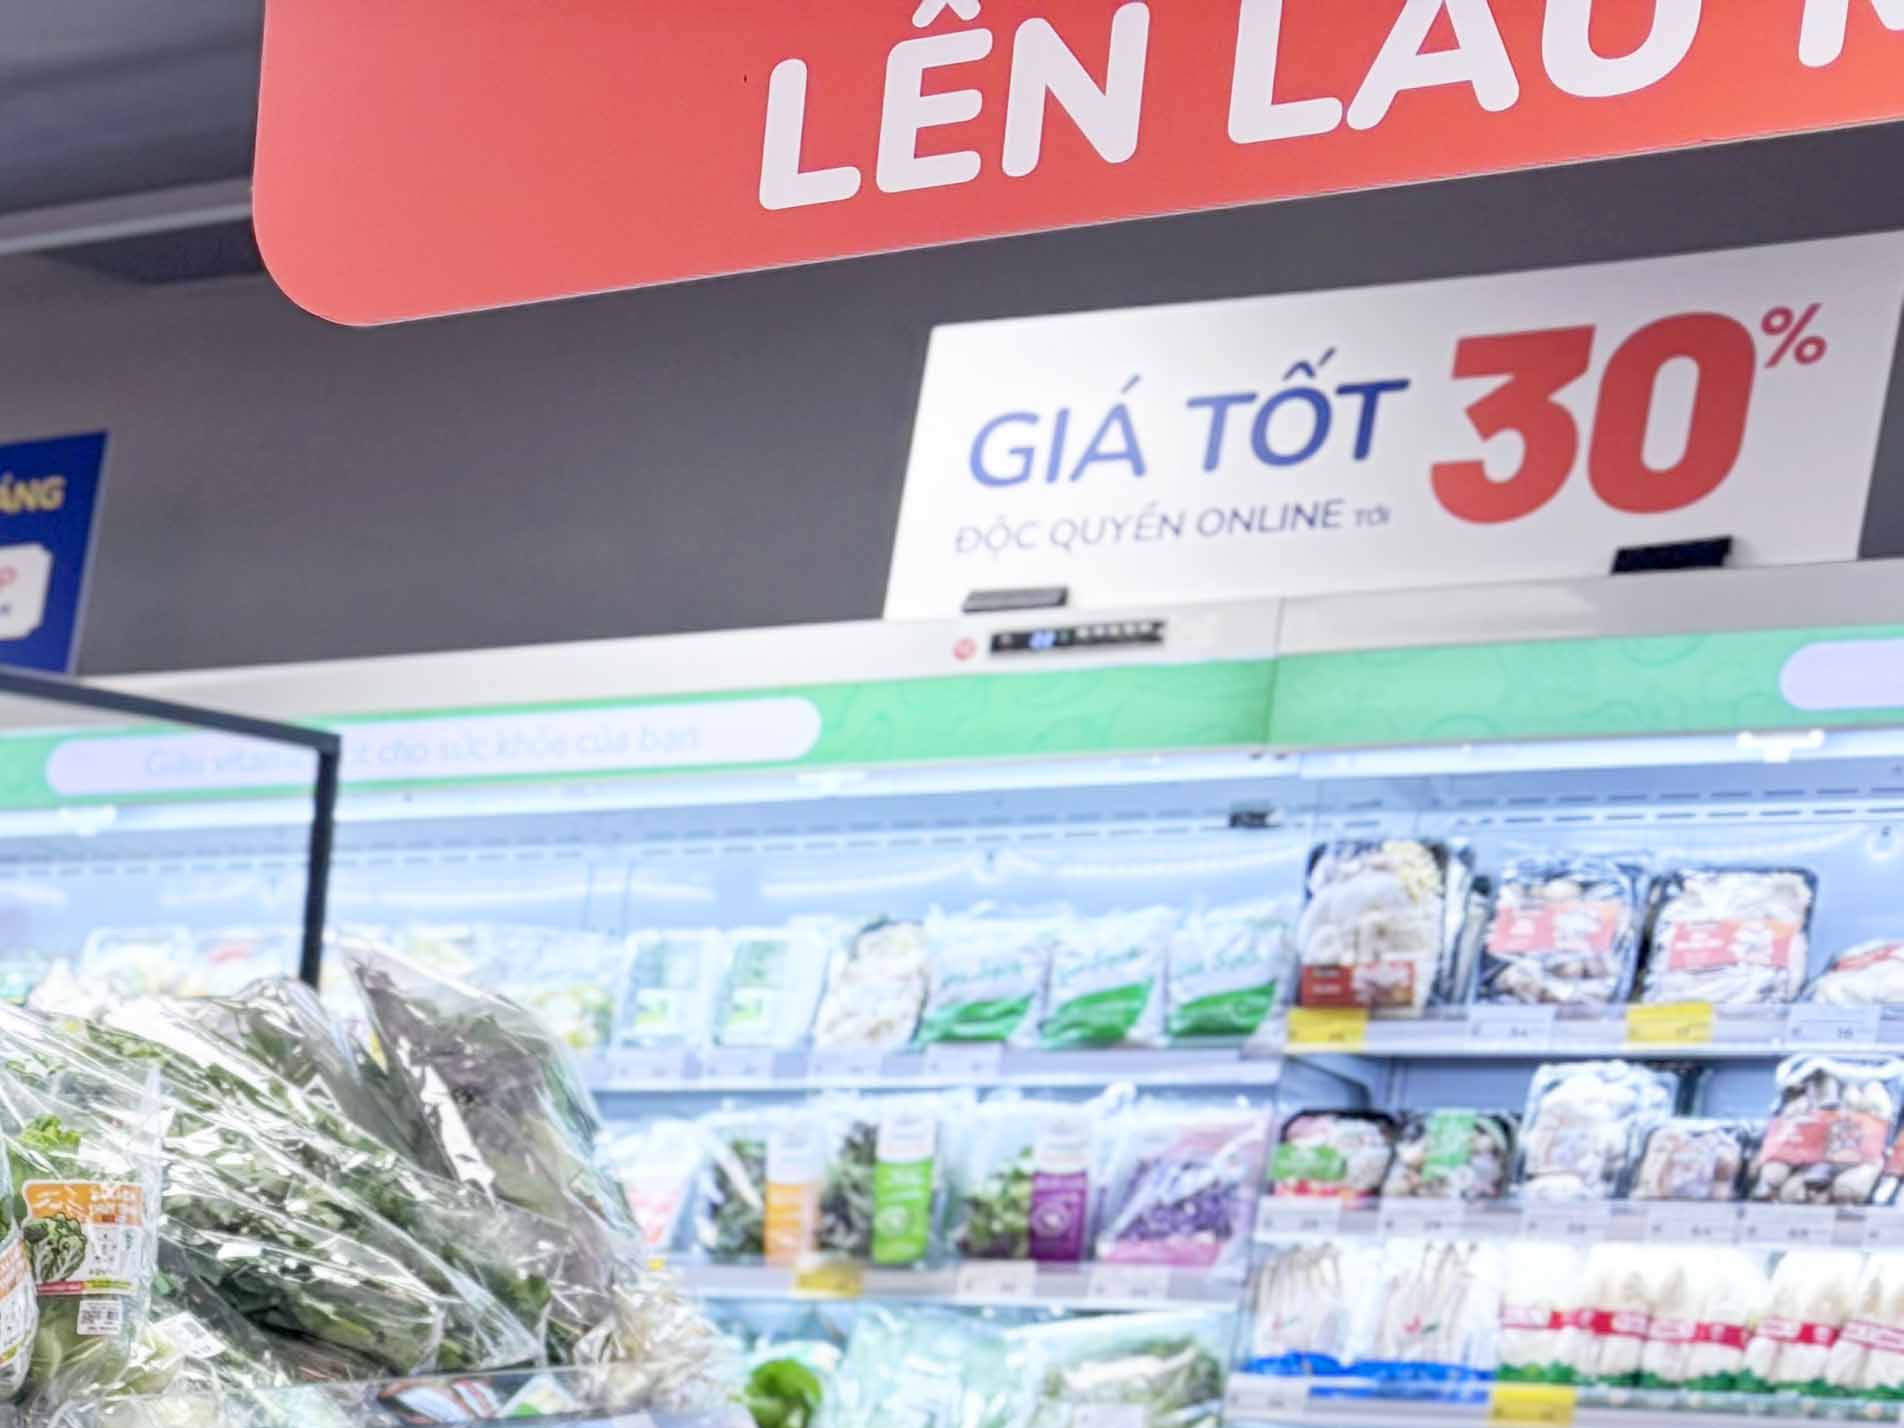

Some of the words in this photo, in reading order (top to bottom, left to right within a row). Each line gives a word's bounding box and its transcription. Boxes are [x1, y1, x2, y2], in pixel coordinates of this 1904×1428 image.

[759, 0, 1151, 210] LÊN
[967, 375, 1147, 489] GIÁ
[1187, 348, 1410, 474] TỐT
[1197, 497, 1345, 537] ONLINE
